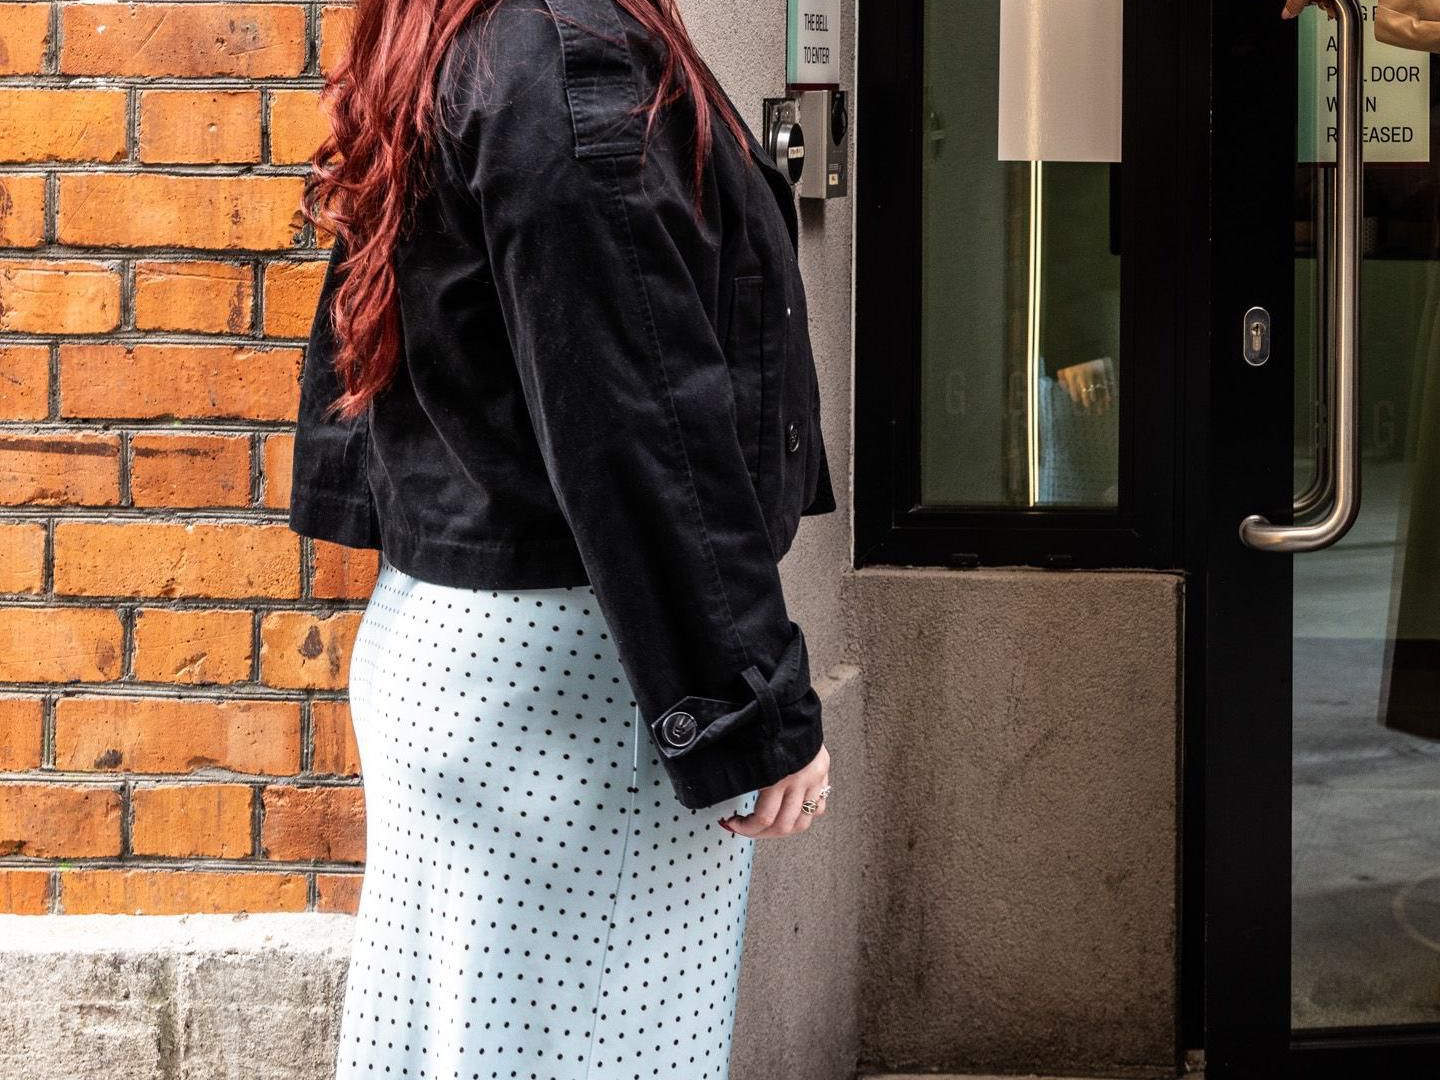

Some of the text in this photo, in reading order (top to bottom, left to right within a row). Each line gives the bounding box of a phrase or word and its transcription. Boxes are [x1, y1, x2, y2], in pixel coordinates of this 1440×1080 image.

[804, 13, 829, 32] THE BELL
[803, 46, 830, 65] TO ENTER
[1371, 66, 1421, 82] DOOR
[1326, 96, 1377, 113] WN
[1327, 127, 1413, 143] REASED
